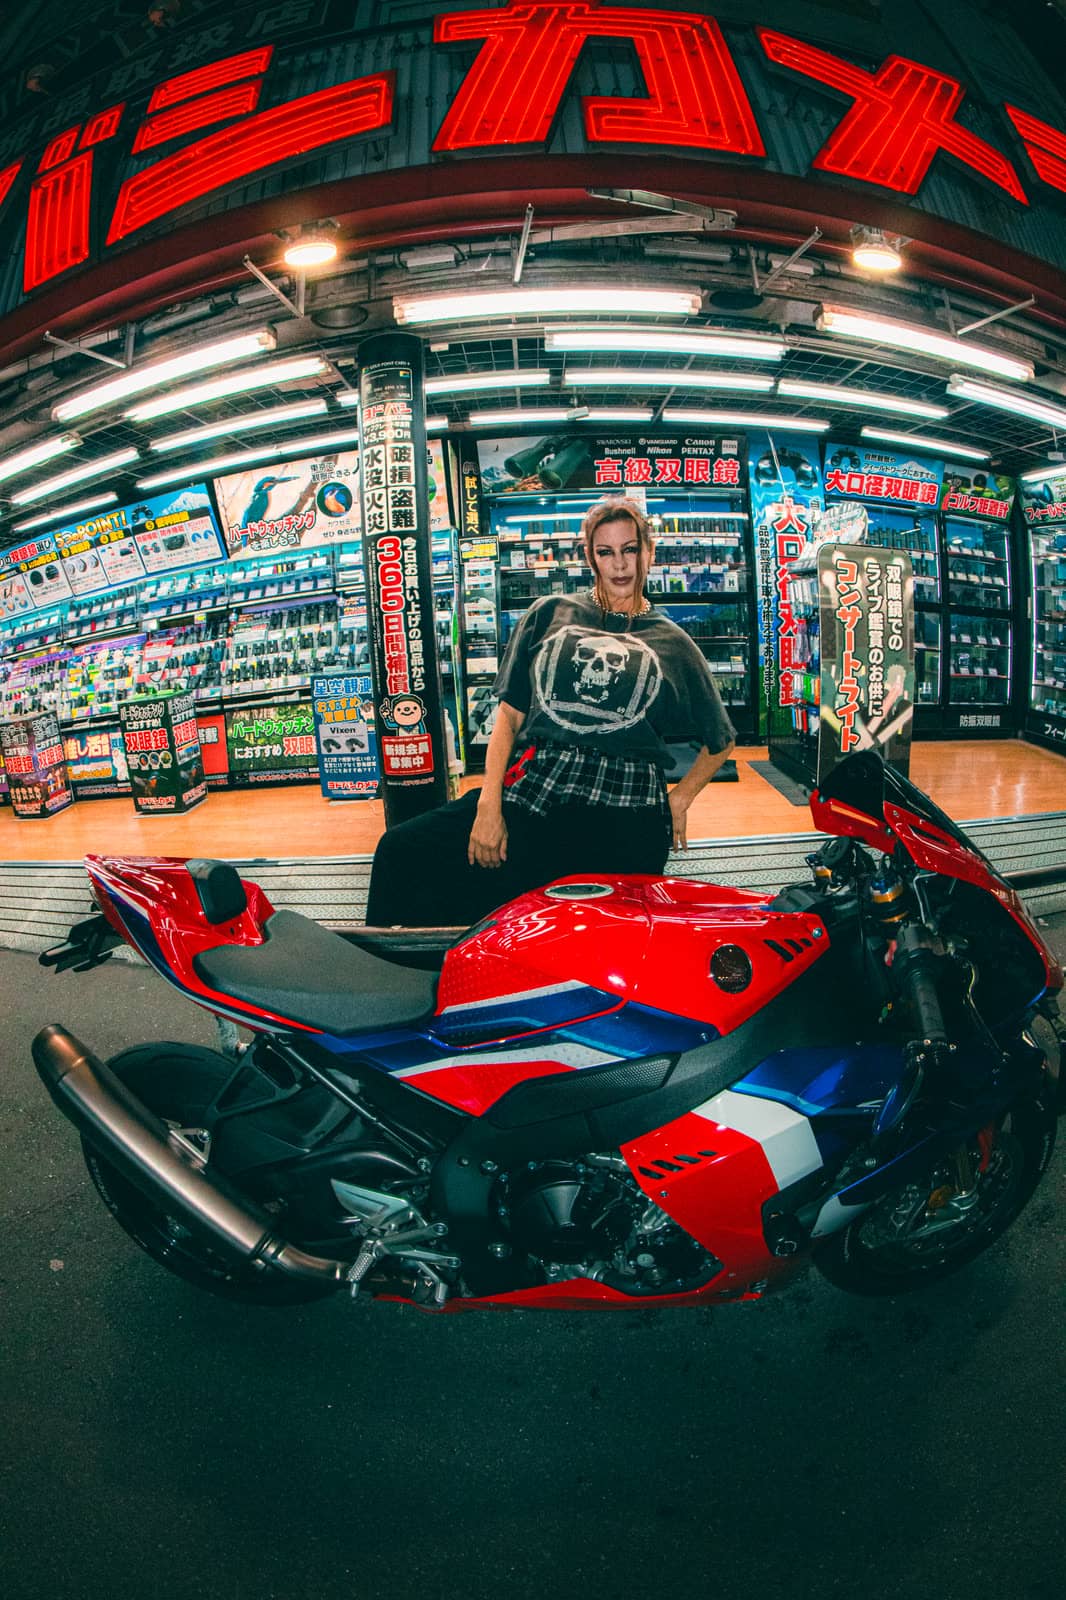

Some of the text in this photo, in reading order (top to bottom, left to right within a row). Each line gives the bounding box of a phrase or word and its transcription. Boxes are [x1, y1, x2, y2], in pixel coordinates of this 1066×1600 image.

[0, 0, 1066, 293] バシカメ
[604, 446, 715, 455] Bushnell Nikon PENTAX
[685, 438, 716, 446] Canon
[365, 448, 383, 488] 水没
[390, 445, 412, 484] 破損
[594, 456, 740, 484] 高級双眼鏡
[825, 469, 939, 505] 大口径双眼鏡
[366, 492, 385, 533] 火災
[391, 489, 415, 529] 盗難
[464, 476, 479, 534] 試して選べ
[949, 491, 1010, 519] ゴルフ距離計
[229, 510, 316, 541] バードウォッチング
[377, 536, 410, 695] 365日間補償
[403, 536, 425, 691] 今日お買い上げの商品から
[886, 565, 904, 651] 双眼鏡での
[866, 563, 884, 717] ライブ鑑賞のお供に
[836, 560, 862, 753] コンサートライト
[172, 717, 198, 747] 双眼鏡
[330, 726, 356, 734] Vixen
[959, 714, 1000, 728] 防振双眼鏡
[124, 728, 169, 753] 双眼鏡
[234, 735, 317, 759] におすすめ 双眼
[385, 741, 429, 756] 新規会員
[390, 755, 424, 769] 募集中
[327, 780, 379, 790] ヨドバシカメラ
